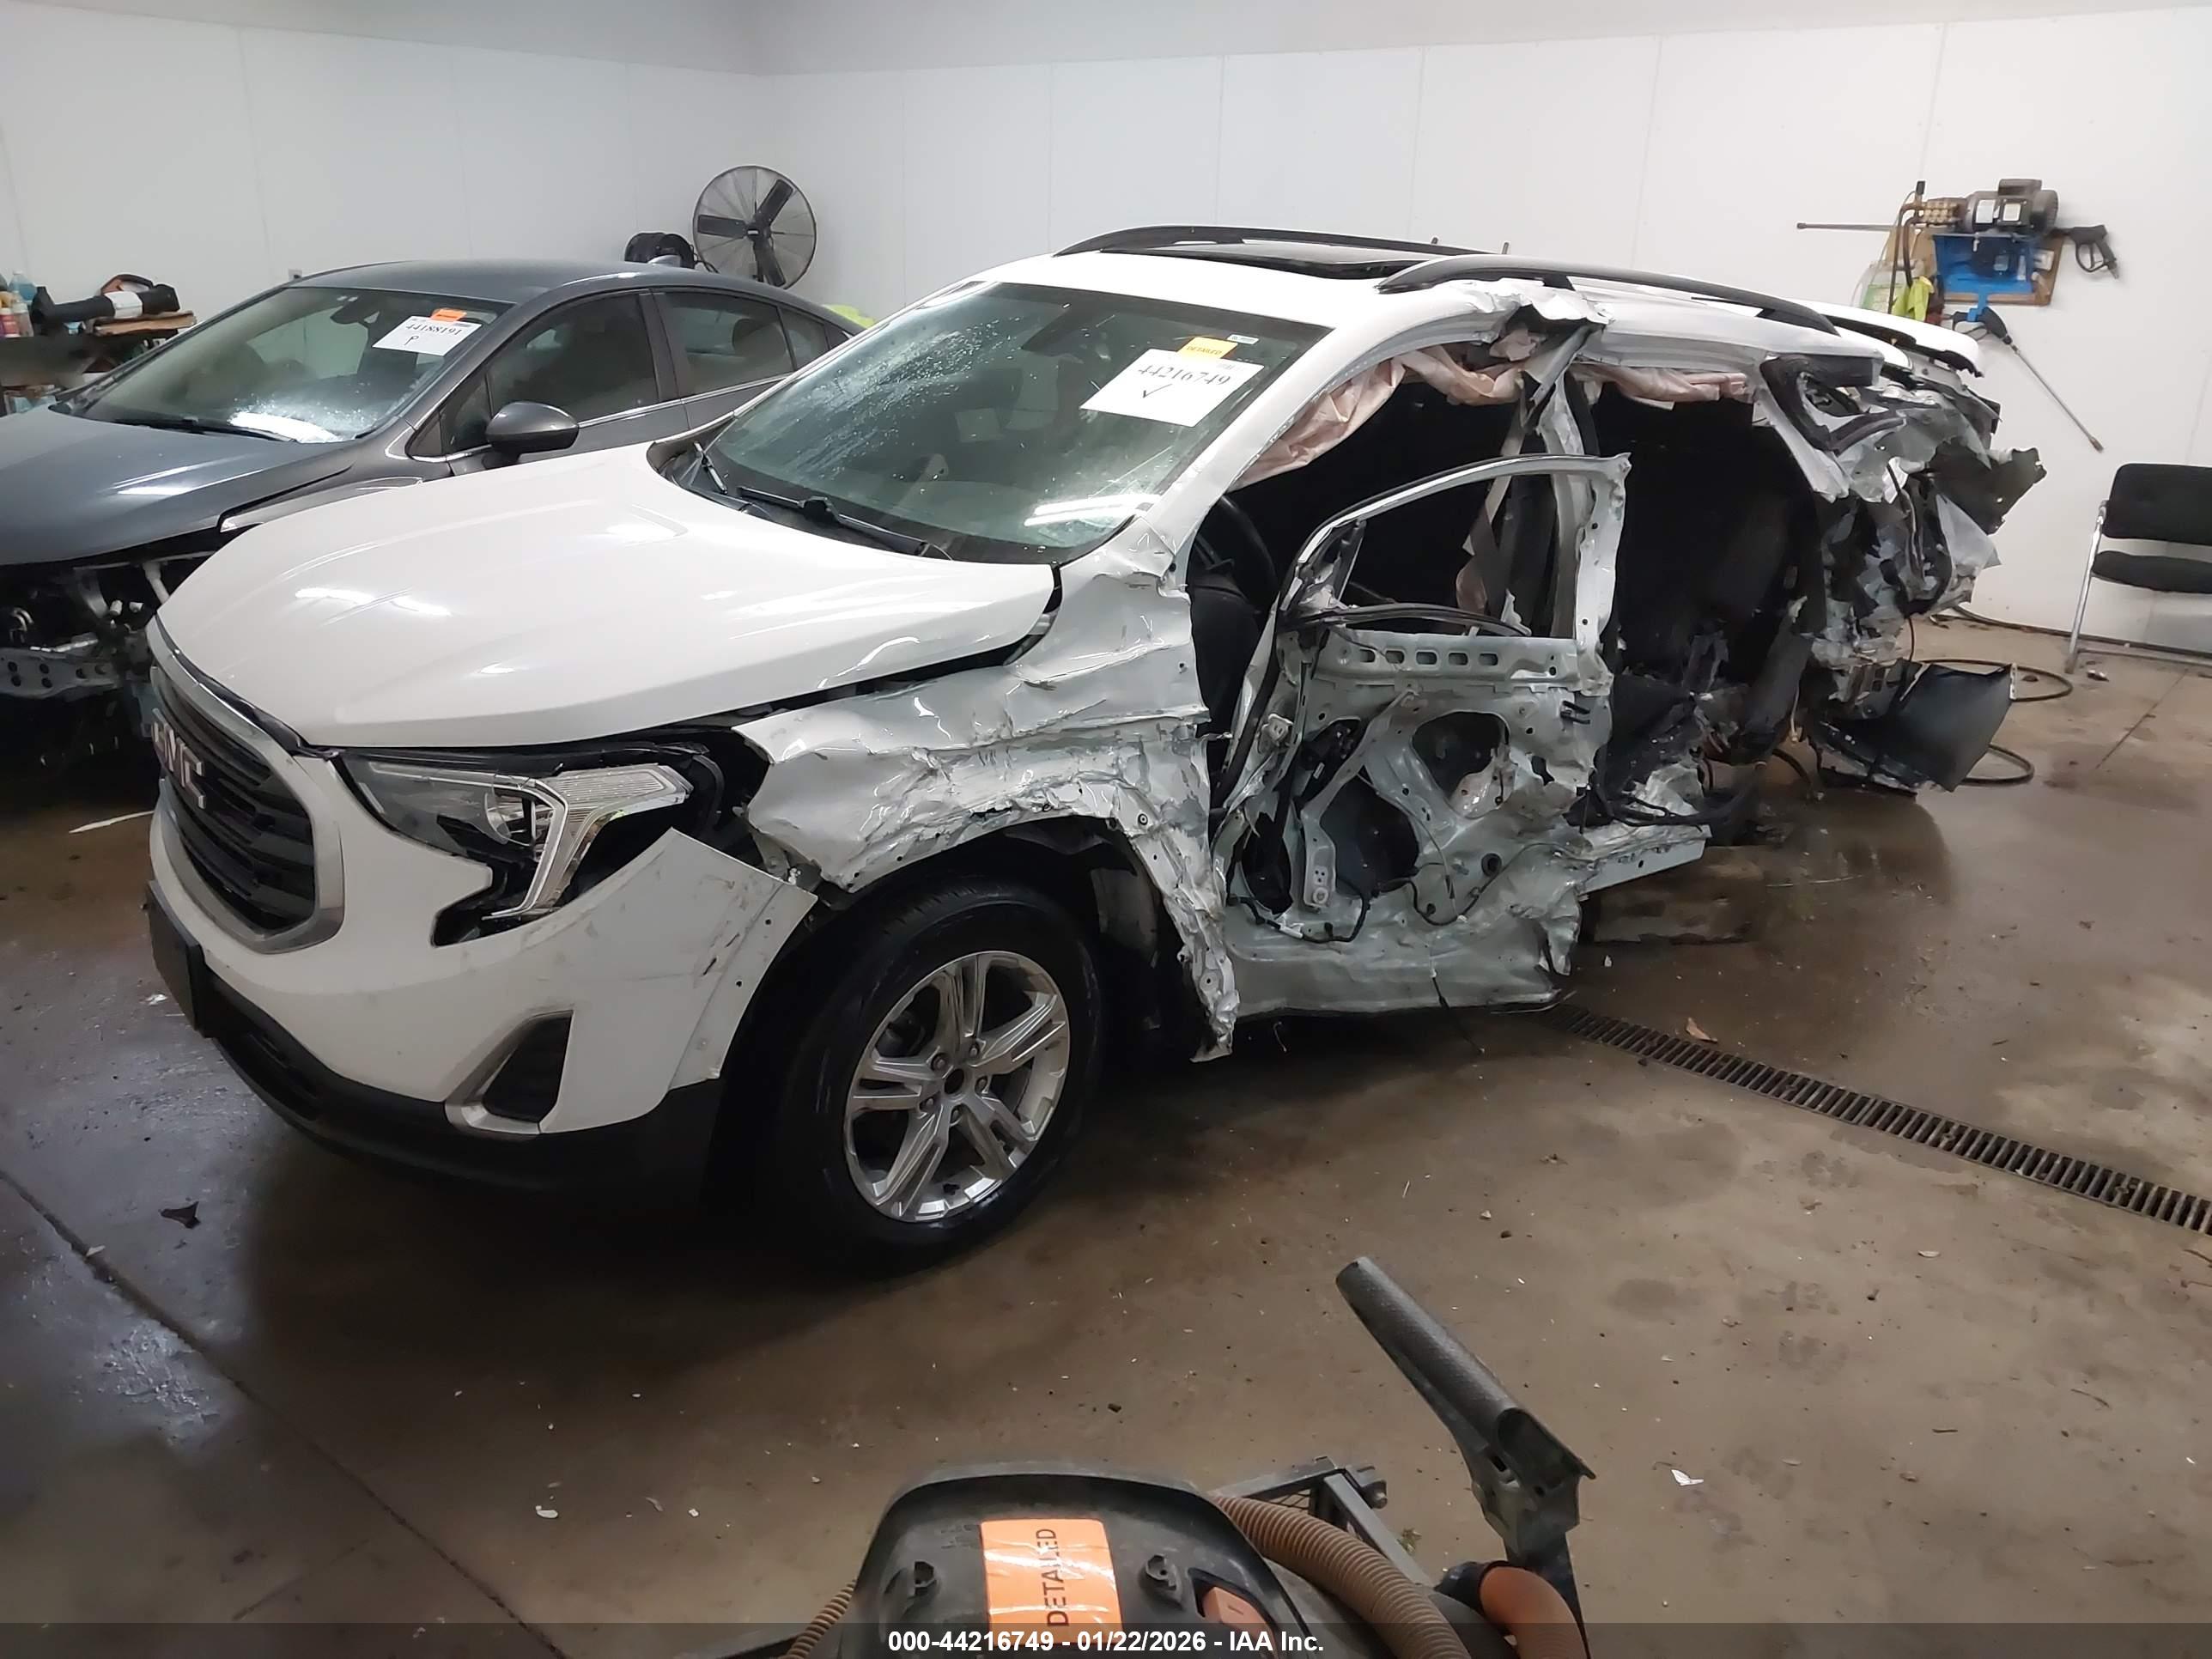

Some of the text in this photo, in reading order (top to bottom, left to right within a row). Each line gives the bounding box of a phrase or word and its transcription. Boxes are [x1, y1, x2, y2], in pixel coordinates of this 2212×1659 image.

[1186, 345, 1224, 356] DETAILED
[1138, 364, 1231, 386] 44216749
[1036, 1528, 1070, 1626] DETAILED
